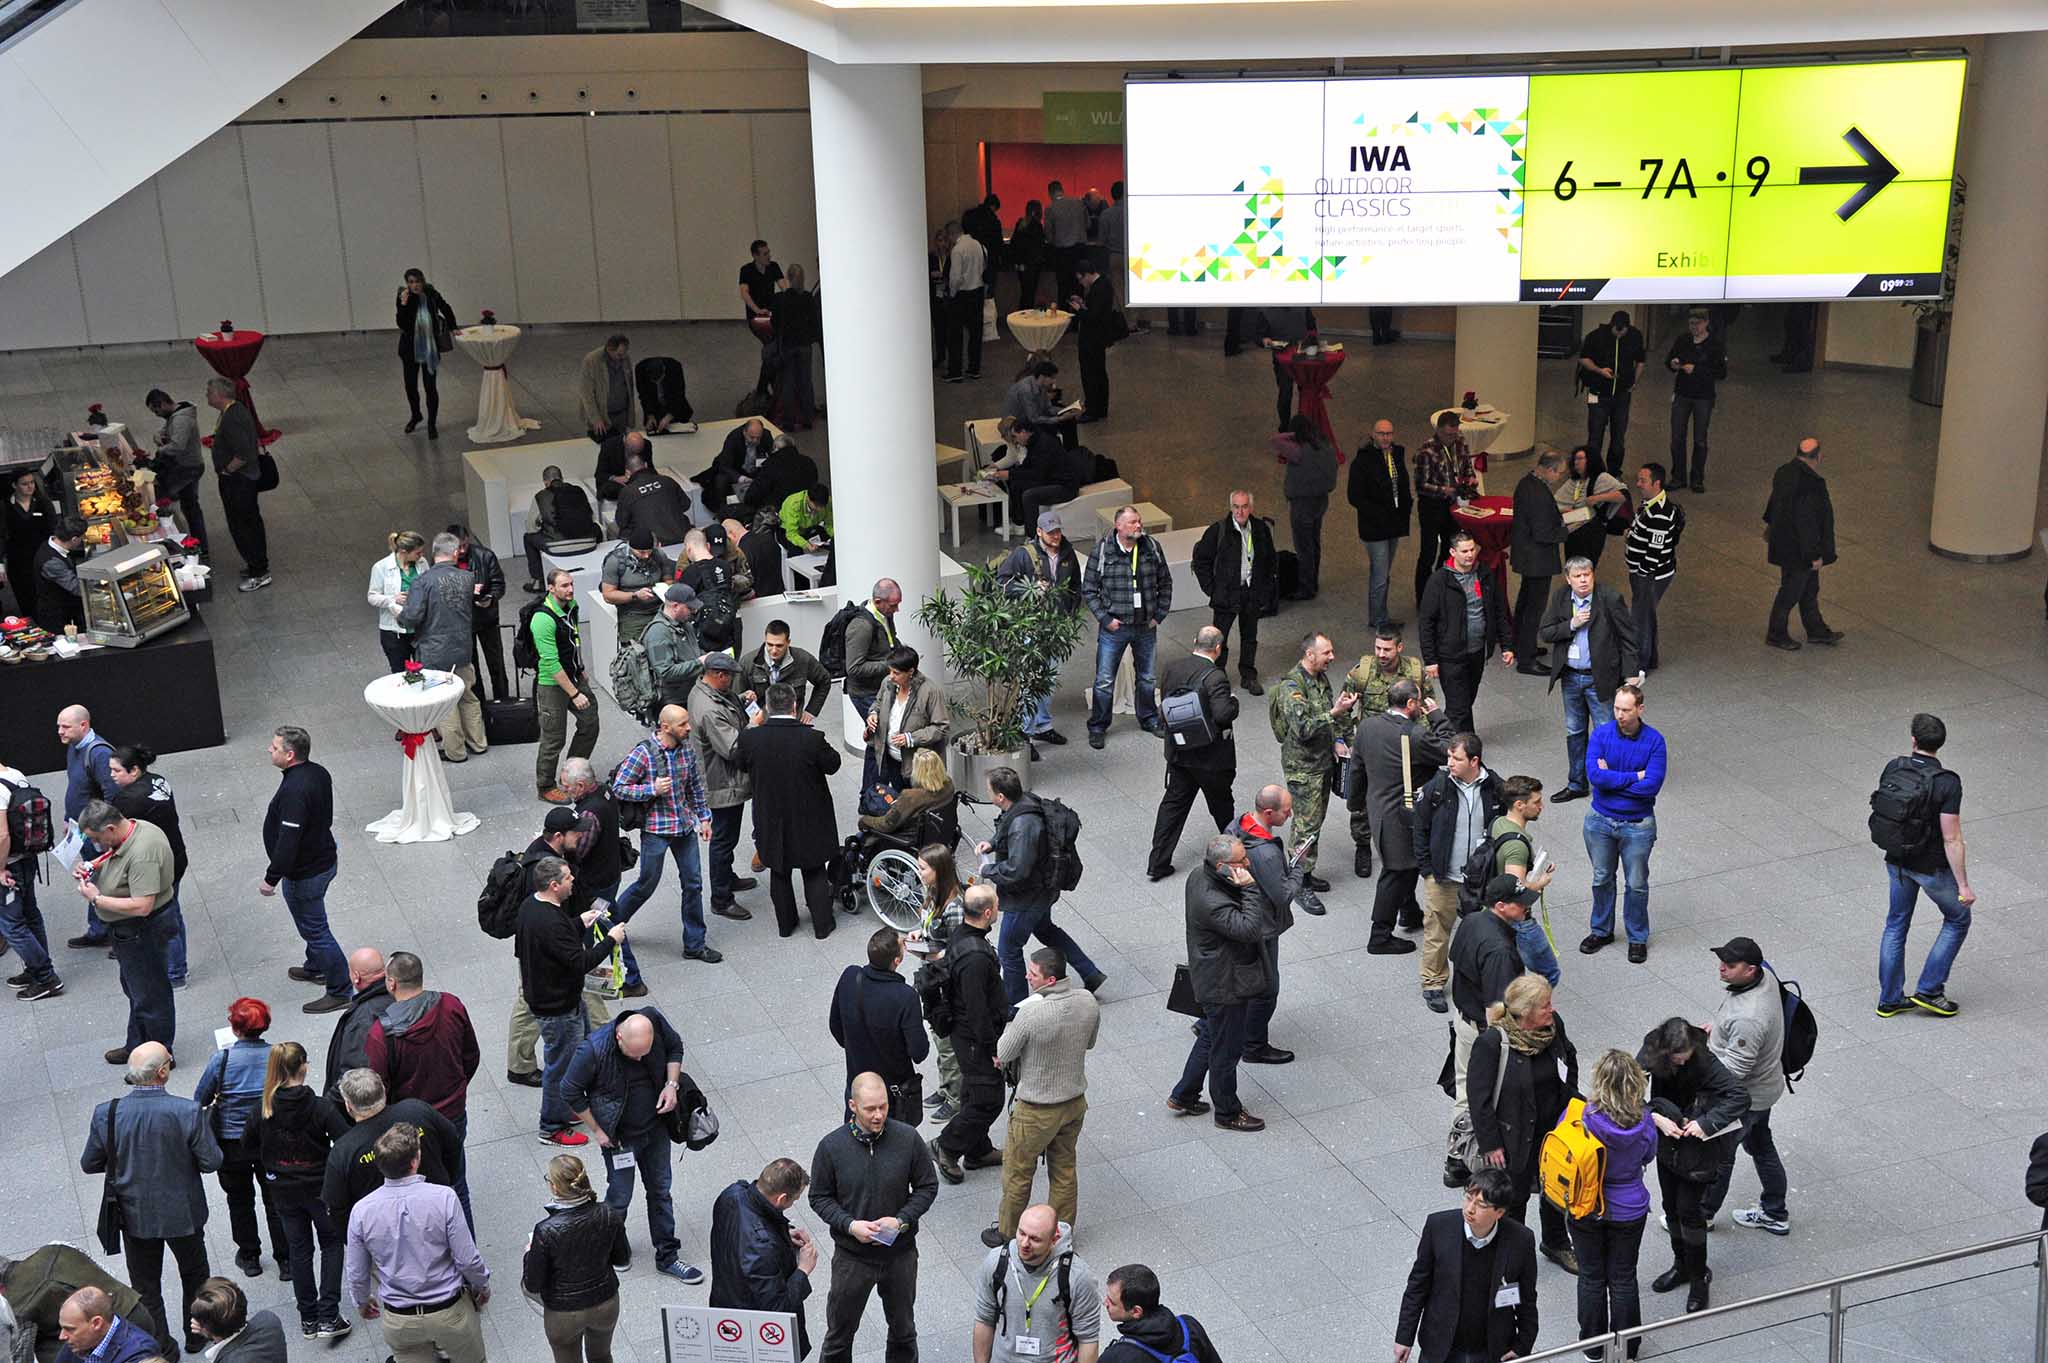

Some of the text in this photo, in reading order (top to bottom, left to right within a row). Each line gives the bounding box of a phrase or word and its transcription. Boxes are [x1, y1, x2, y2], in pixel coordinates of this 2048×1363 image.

[1349, 145, 1412, 173] IWA
[1314, 176, 1412, 195] OUTDOOR
[1553, 160, 1577, 202] 6
[1639, 157, 1698, 200] 7A
[1745, 155, 1771, 198] 9
[1314, 198, 1412, 218] CLASSICS
[638, 480, 662, 494] DTC
